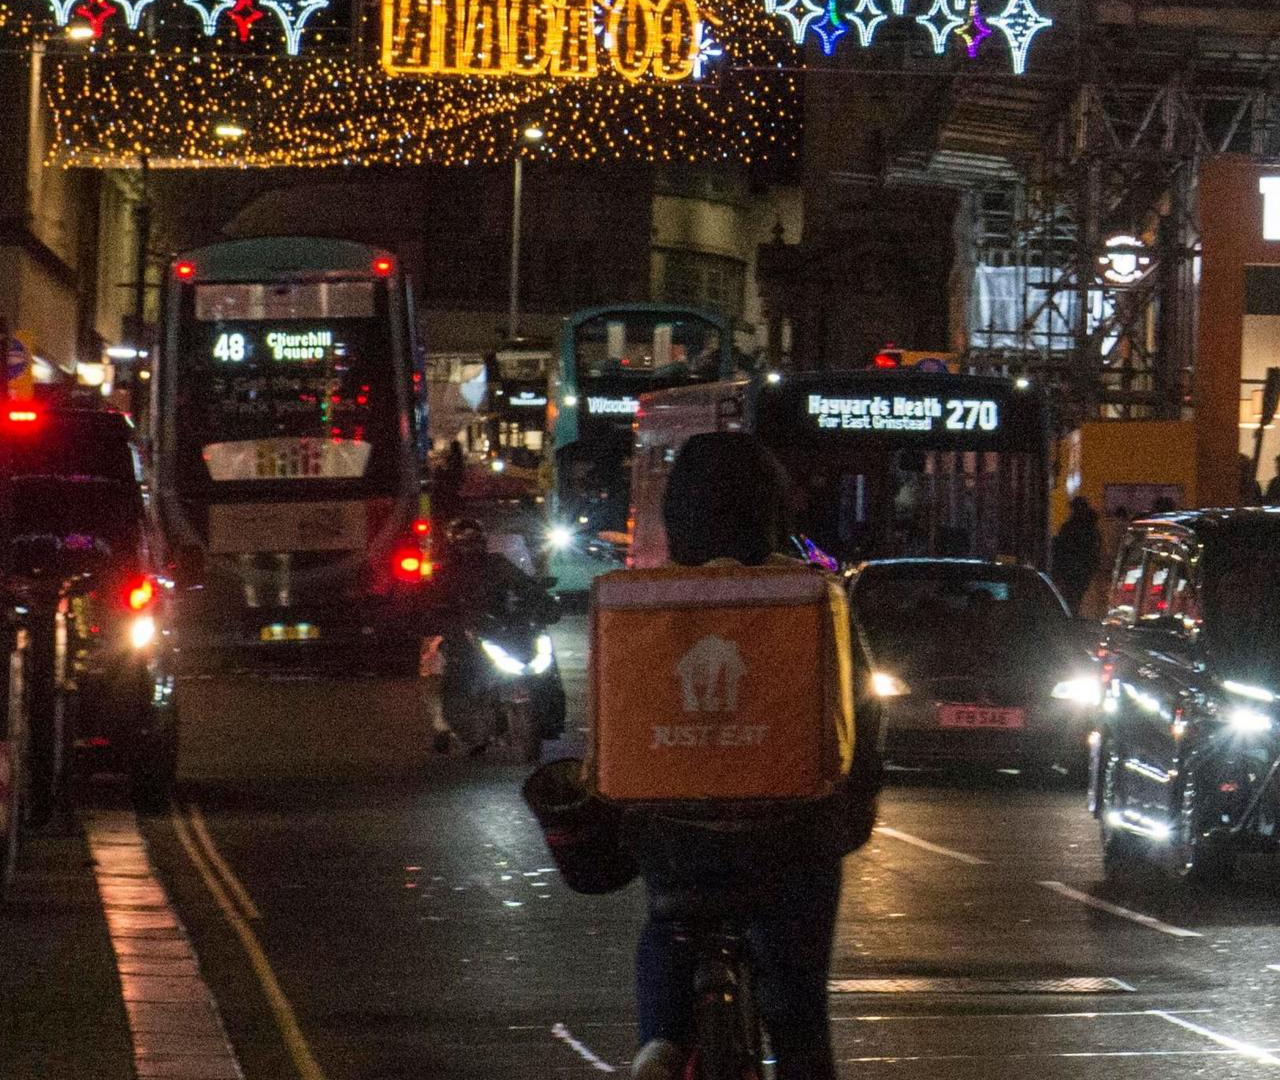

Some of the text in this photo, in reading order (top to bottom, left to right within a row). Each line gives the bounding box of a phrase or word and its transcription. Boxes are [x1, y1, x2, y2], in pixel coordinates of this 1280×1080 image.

[214, 332, 331, 361] 48 Churchill
[274, 346, 323, 360] Square
[808, 395, 998, 430] Haywards Heath 270
[817, 414, 932, 430] for East Grinstead
[653, 725, 769, 747] JUST EAT
